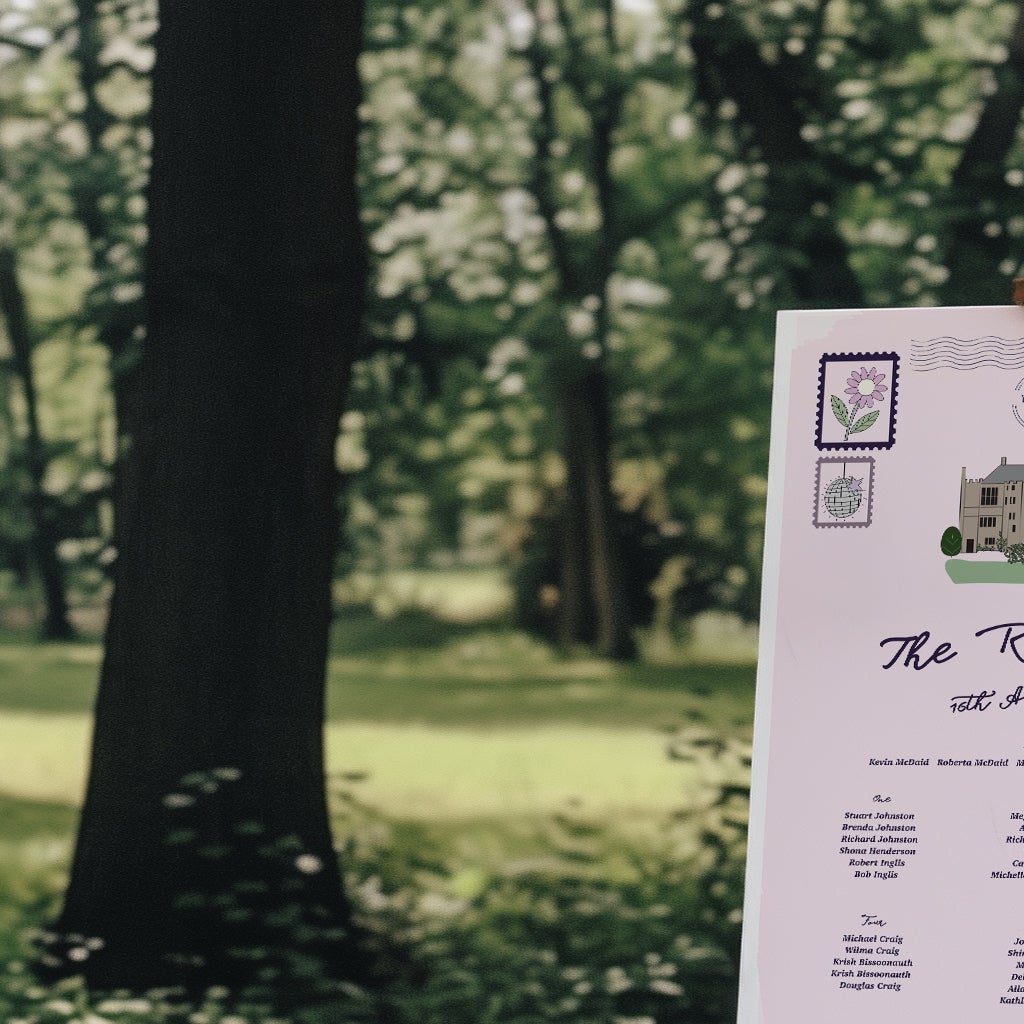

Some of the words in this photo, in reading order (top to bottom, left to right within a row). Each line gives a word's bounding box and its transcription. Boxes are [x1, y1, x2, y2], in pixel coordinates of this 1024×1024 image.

[879, 630, 958, 671] The
[950, 690, 996, 714] 16th
[868, 758, 894, 766] Kevin
[895, 758, 930, 766] McDaid
[936, 758, 972, 767] Roberta
[974, 758, 1009, 767] McDaid
[872, 794, 892, 803] One
[844, 811, 873, 820] Stuart
[873, 812, 915, 820] Johnston
[841, 823, 874, 831] Brenda
[874, 823, 917, 832] Johnston
[840, 835, 876, 843] Richard
[877, 835, 918, 844] Johnston
[839, 846, 867, 855] Shona
[868, 847, 917, 855] Henderson
[848, 858, 878, 867] Robert
[879, 859, 906, 869] Inglis
[854, 870, 872, 878] Bob
[873, 870, 898, 880] Inglis
[860, 913, 887, 927] Four
[842, 934, 878, 943] Michael
[879, 935, 904, 945] Craig
[845, 946, 874, 954] Wilma
[875, 946, 900, 956] Craig
[833, 957, 857, 966] Krish
[858, 958, 914, 967] Bissoonauth
[830, 969, 854, 978] Krish
[856, 970, 911, 979] Bissoonauth
[839, 981, 875, 991] Douglas
[876, 982, 902, 992] Craig
